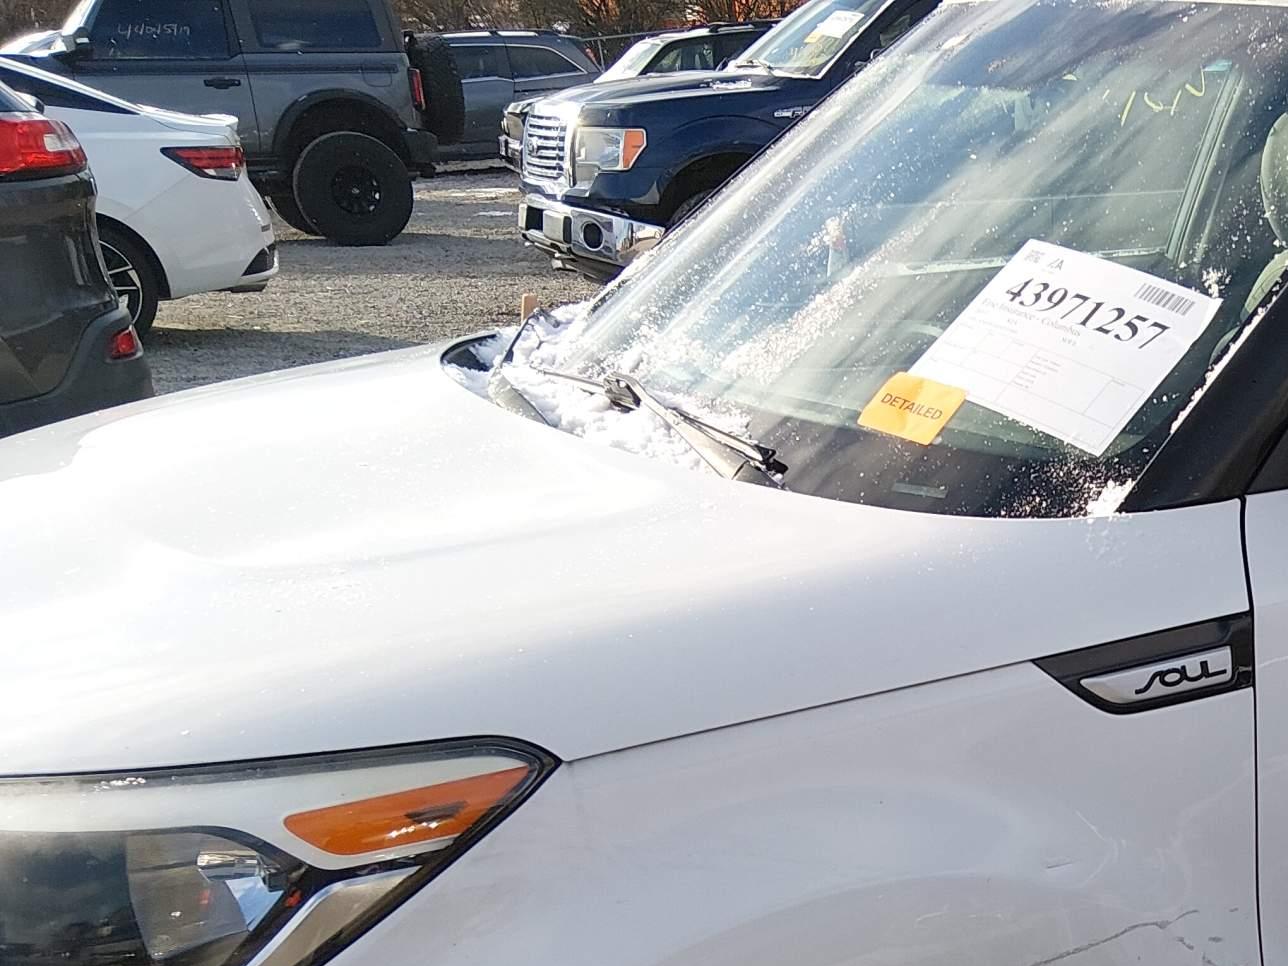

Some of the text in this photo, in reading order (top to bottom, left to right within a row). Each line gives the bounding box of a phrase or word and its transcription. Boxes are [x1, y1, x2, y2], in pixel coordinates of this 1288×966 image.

[1004, 277, 1171, 350] 43971257
[880, 392, 943, 420] DETAILED
[1135, 660, 1227, 695] SOUL
